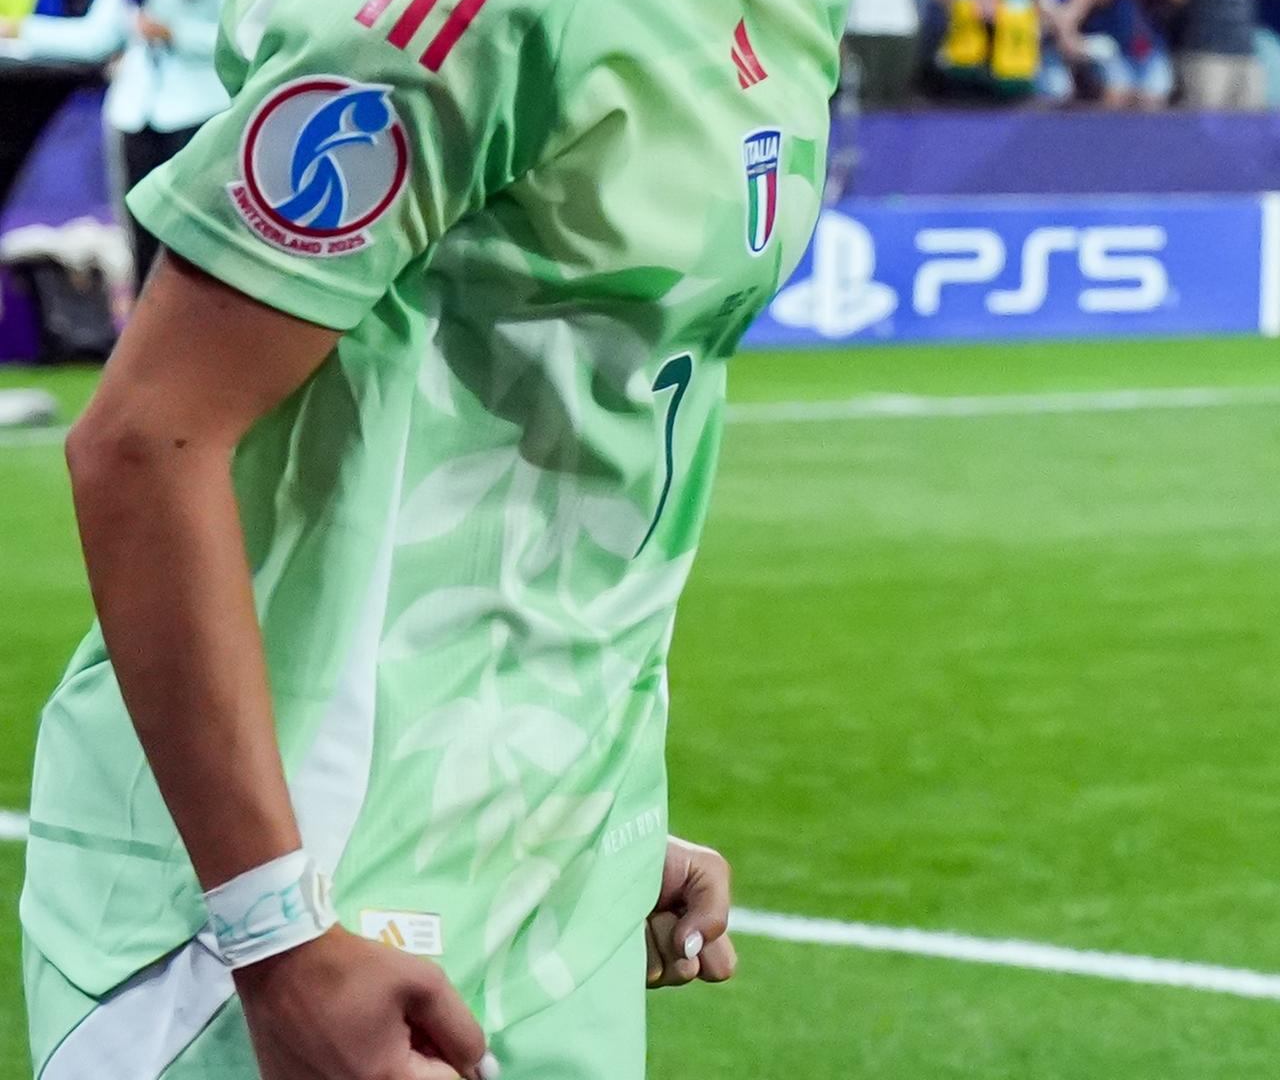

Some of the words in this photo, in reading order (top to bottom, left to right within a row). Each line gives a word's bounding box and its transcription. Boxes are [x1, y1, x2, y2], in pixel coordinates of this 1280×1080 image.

[232, 185, 322, 254] SWITZERLAND
[327, 233, 366, 253] 2025
[912, 225, 1170, 316] PS5
